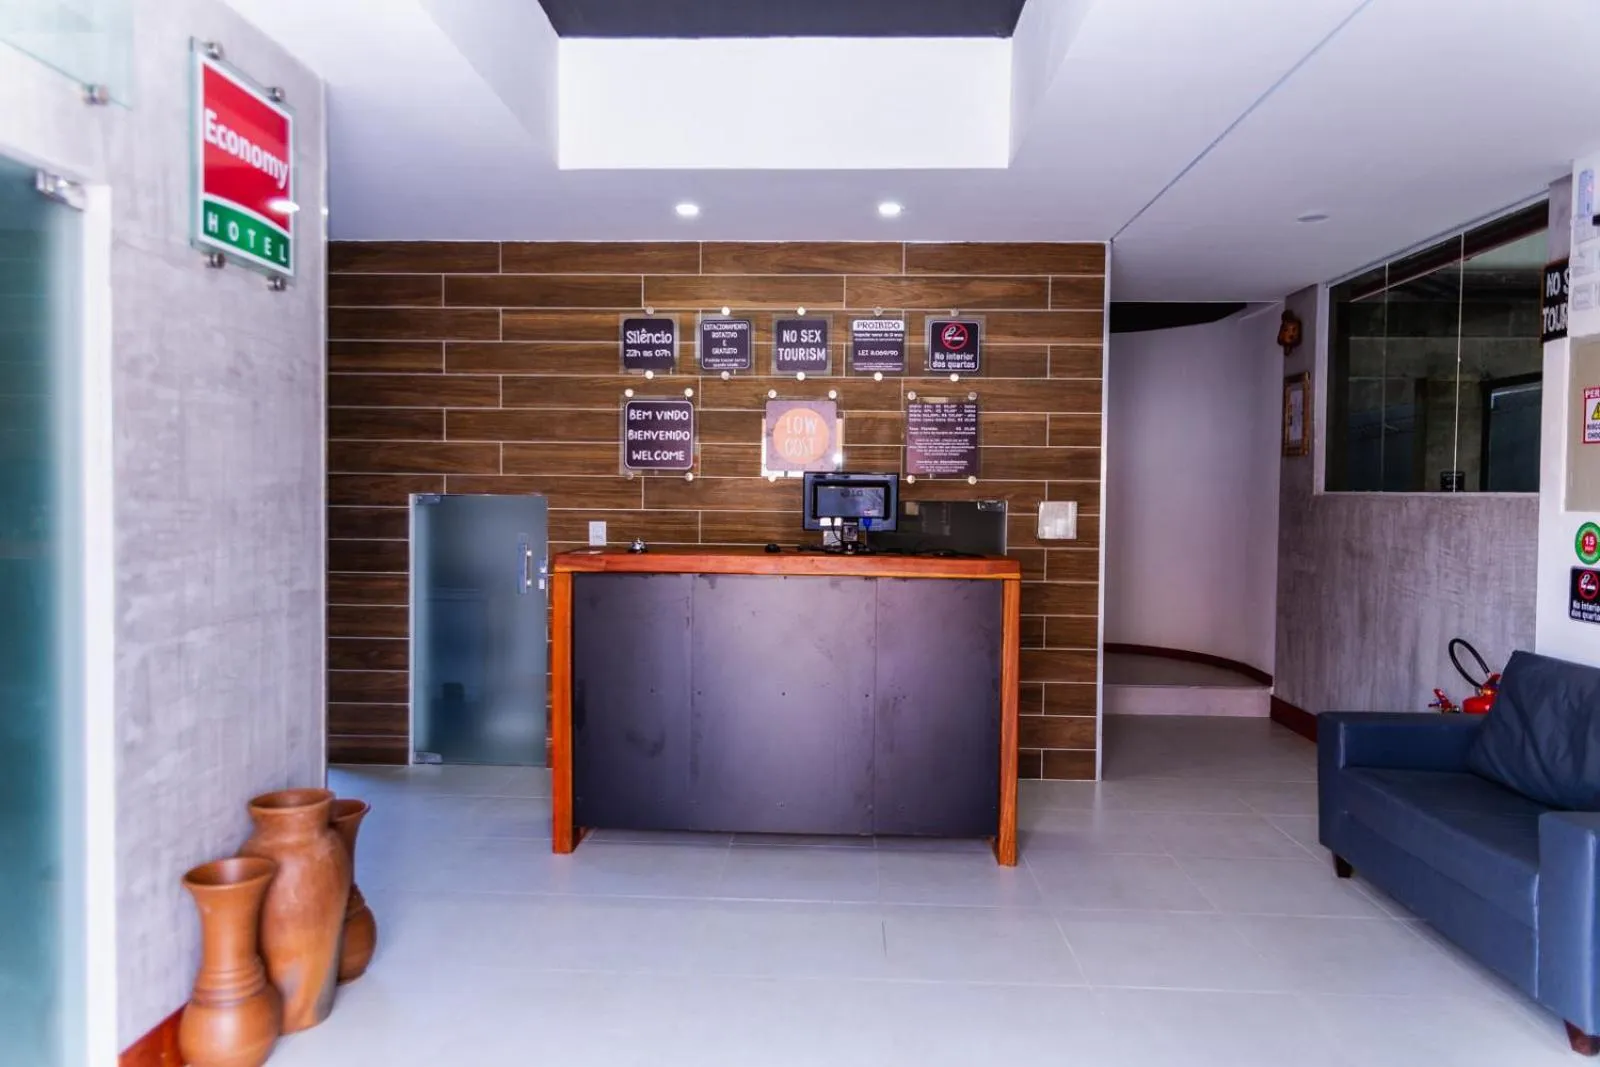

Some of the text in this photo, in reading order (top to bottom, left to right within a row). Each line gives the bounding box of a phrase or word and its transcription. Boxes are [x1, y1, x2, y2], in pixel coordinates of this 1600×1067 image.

[204, 108, 288, 189] Economy
[207, 210, 287, 263] HOTEL
[1546, 271, 1561, 298] NO
[703, 323, 748, 331] ESTACIONAMENTO
[857, 321, 900, 330] PROIBIDO
[626, 328, 672, 345] Silêncio
[712, 331, 738, 339] ROTATIVO
[783, 329, 821, 343] NO SEX
[722, 339, 728, 347] E
[626, 349, 641, 358] 22h
[654, 349, 671, 358] 07h
[712, 347, 738, 355] GRATUITO
[778, 347, 827, 361] TOURISM
[934, 352, 974, 361] No interior
[932, 360, 976, 369] dos quartos
[629, 408, 689, 421] BEM VINDO
[786, 416, 818, 435] LOW
[628, 429, 690, 441] BIENVENIDO
[632, 450, 685, 461] WELCOME
[1585, 535, 1595, 546] 15
